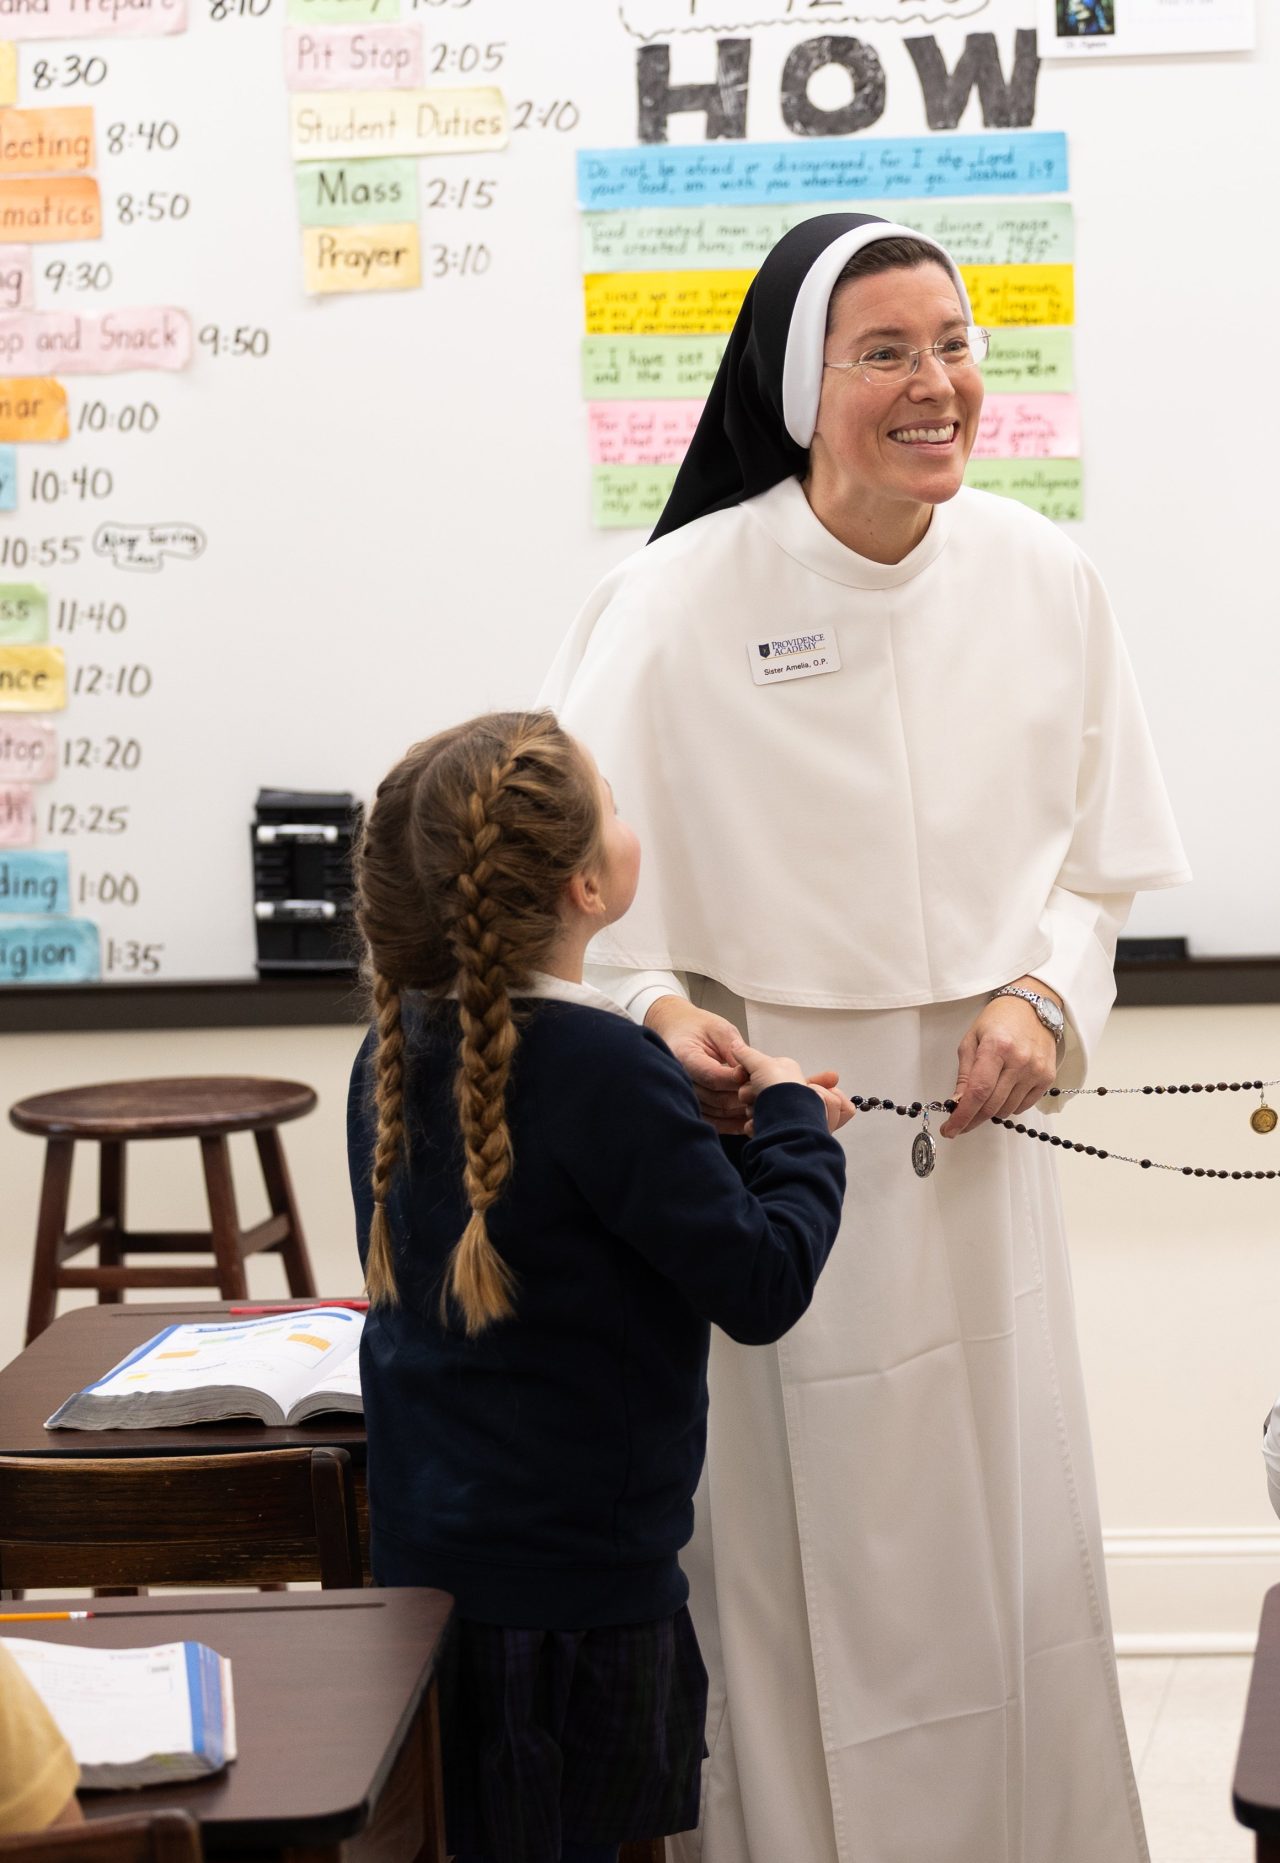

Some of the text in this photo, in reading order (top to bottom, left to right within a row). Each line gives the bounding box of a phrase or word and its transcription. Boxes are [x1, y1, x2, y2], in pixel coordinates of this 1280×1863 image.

[32, 54, 109, 91] 8:30
[297, 34, 412, 81] Pit Stop
[431, 40, 507, 75] 2:05
[635, 28, 1041, 144] HOW
[296, 102, 502, 145] Student Duties
[513, 99, 581, 133] 2:10
[0, 132, 91, 170] eeting
[106, 119, 180, 156] 8:40
[316, 168, 402, 208] Mass
[426, 178, 499, 210] 2:15
[116, 190, 191, 226] 8:50
[317, 232, 411, 279] Prayer
[431, 243, 493, 279] 3:10
[44, 260, 114, 295] 9:30
[36, 316, 82, 352] and
[100, 313, 179, 351] Snack
[197, 323, 271, 359] 9:50
[77, 400, 160, 434] 10:00
[30, 466, 115, 505] 10:40
[0, 535, 84, 569] 10:55
[56, 599, 128, 634] 11:40
[771, 633, 825, 650] PROVIDENCE
[774, 642, 817, 657] ACADEMY
[72, 663, 153, 698] 12:10
[764, 666, 784, 676] Sister
[812, 658, 829, 667] O.P.
[63, 735, 142, 771] 12:20
[47, 803, 131, 837] 12:25
[79, 872, 140, 906] 1:00
[105, 936, 166, 976] 1:35
